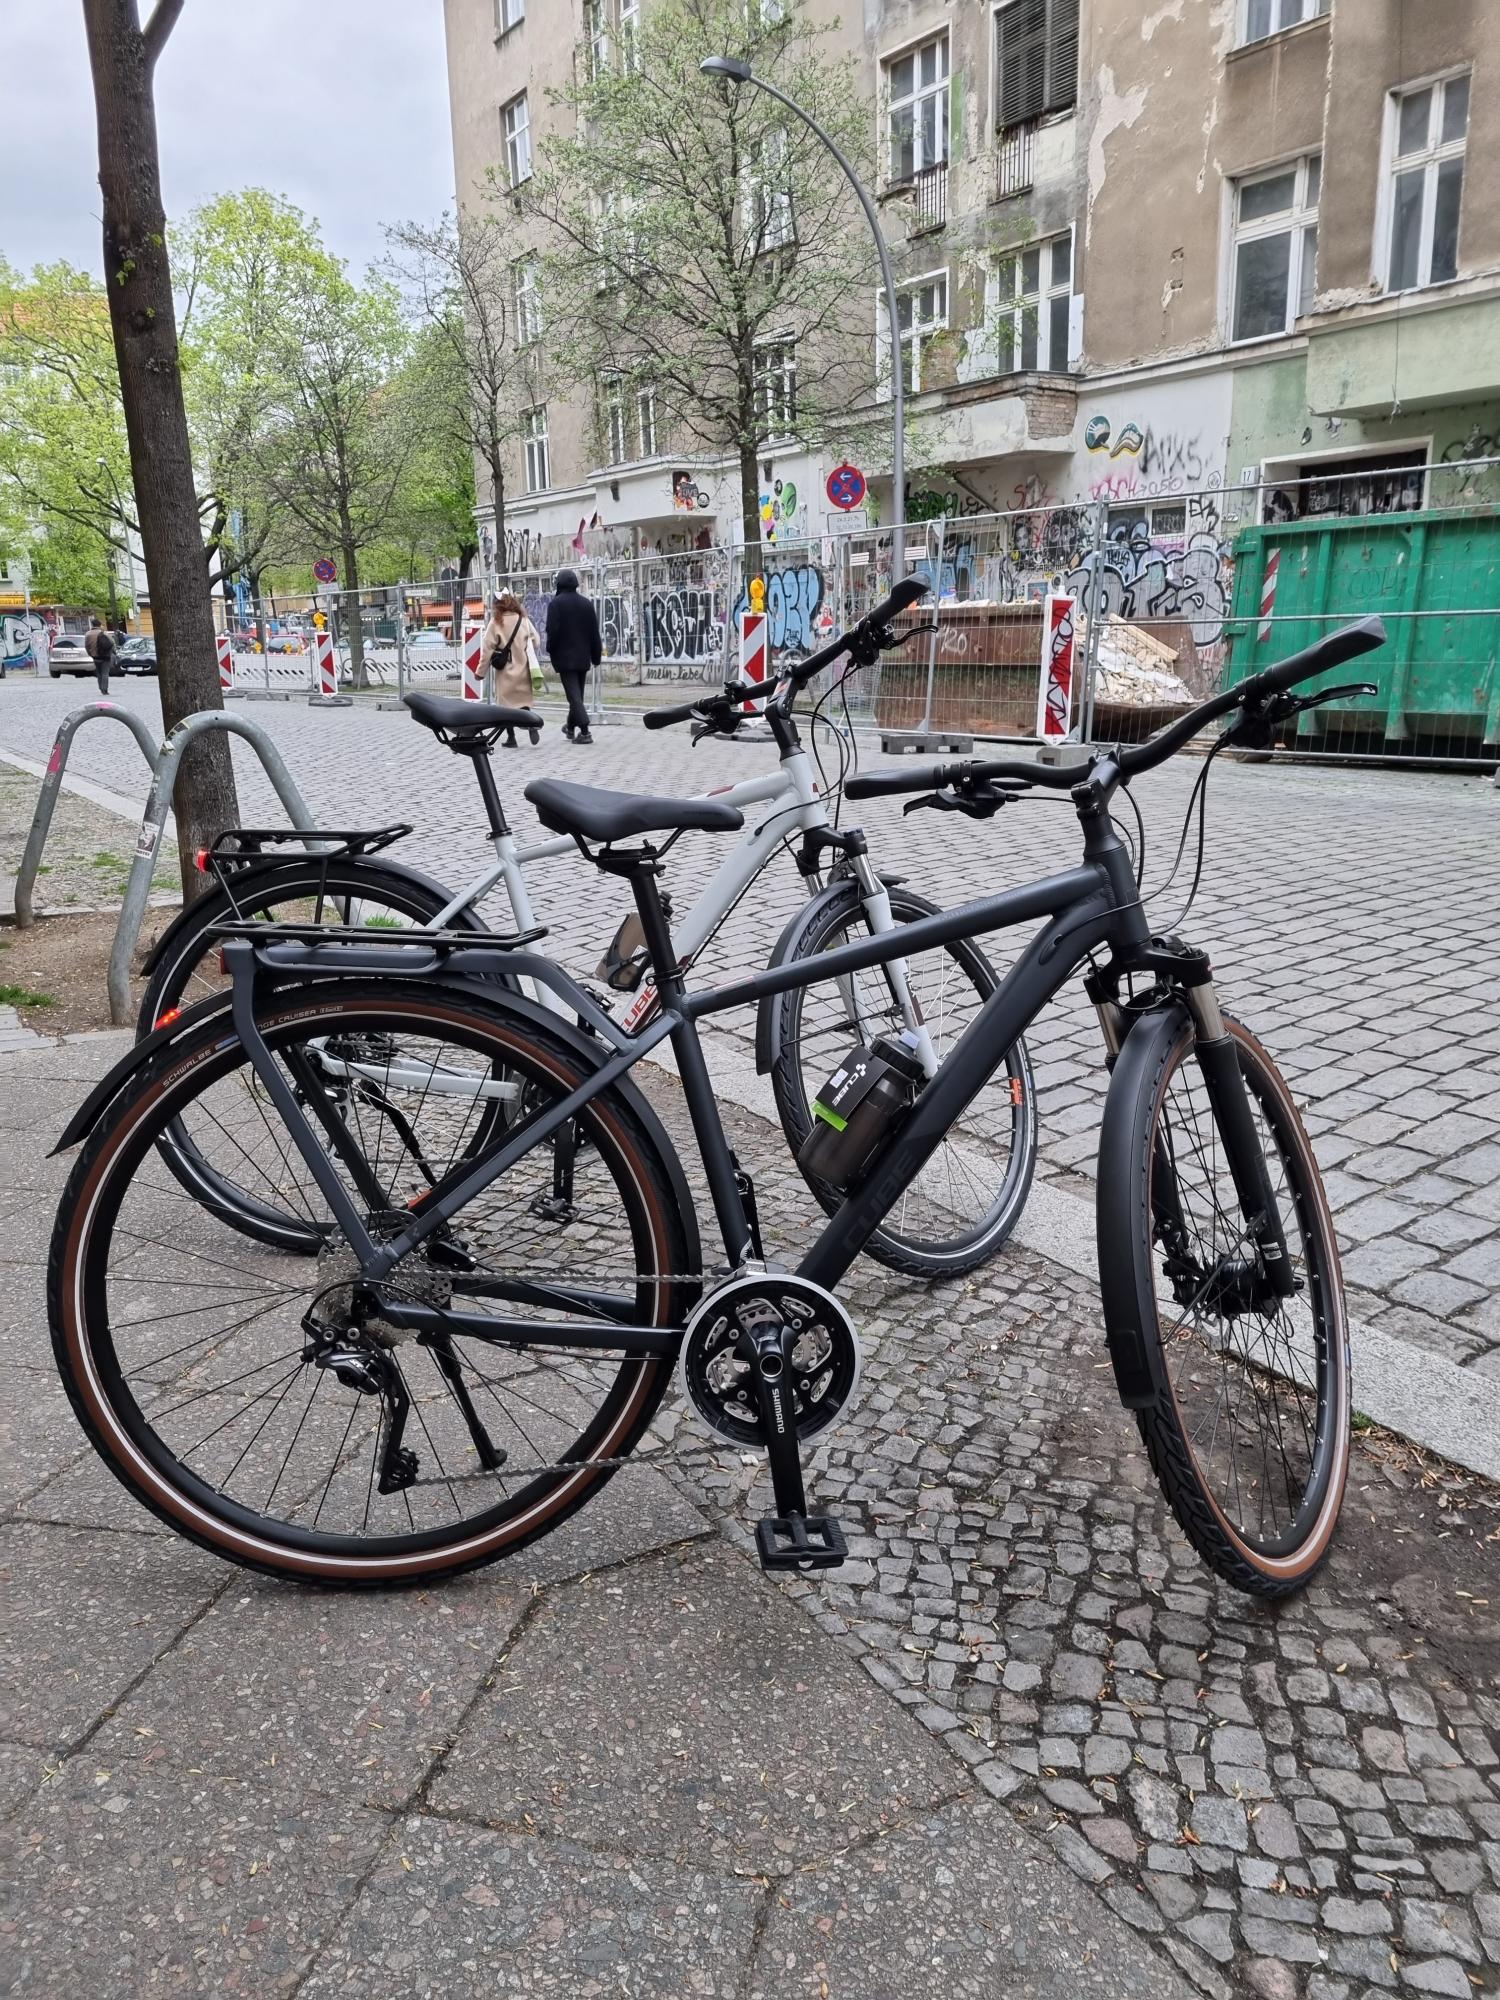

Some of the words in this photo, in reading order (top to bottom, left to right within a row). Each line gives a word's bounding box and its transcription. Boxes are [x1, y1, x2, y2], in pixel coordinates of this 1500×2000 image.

[1243, 470, 1252, 482] 17
[278, 1008, 317, 1024] CRUISER
[621, 984, 658, 1032] UBE
[162, 1049, 213, 1088] SCHWALBE
[832, 1072, 859, 1107] CUBE
[770, 1387, 785, 1435] SHIMANO
